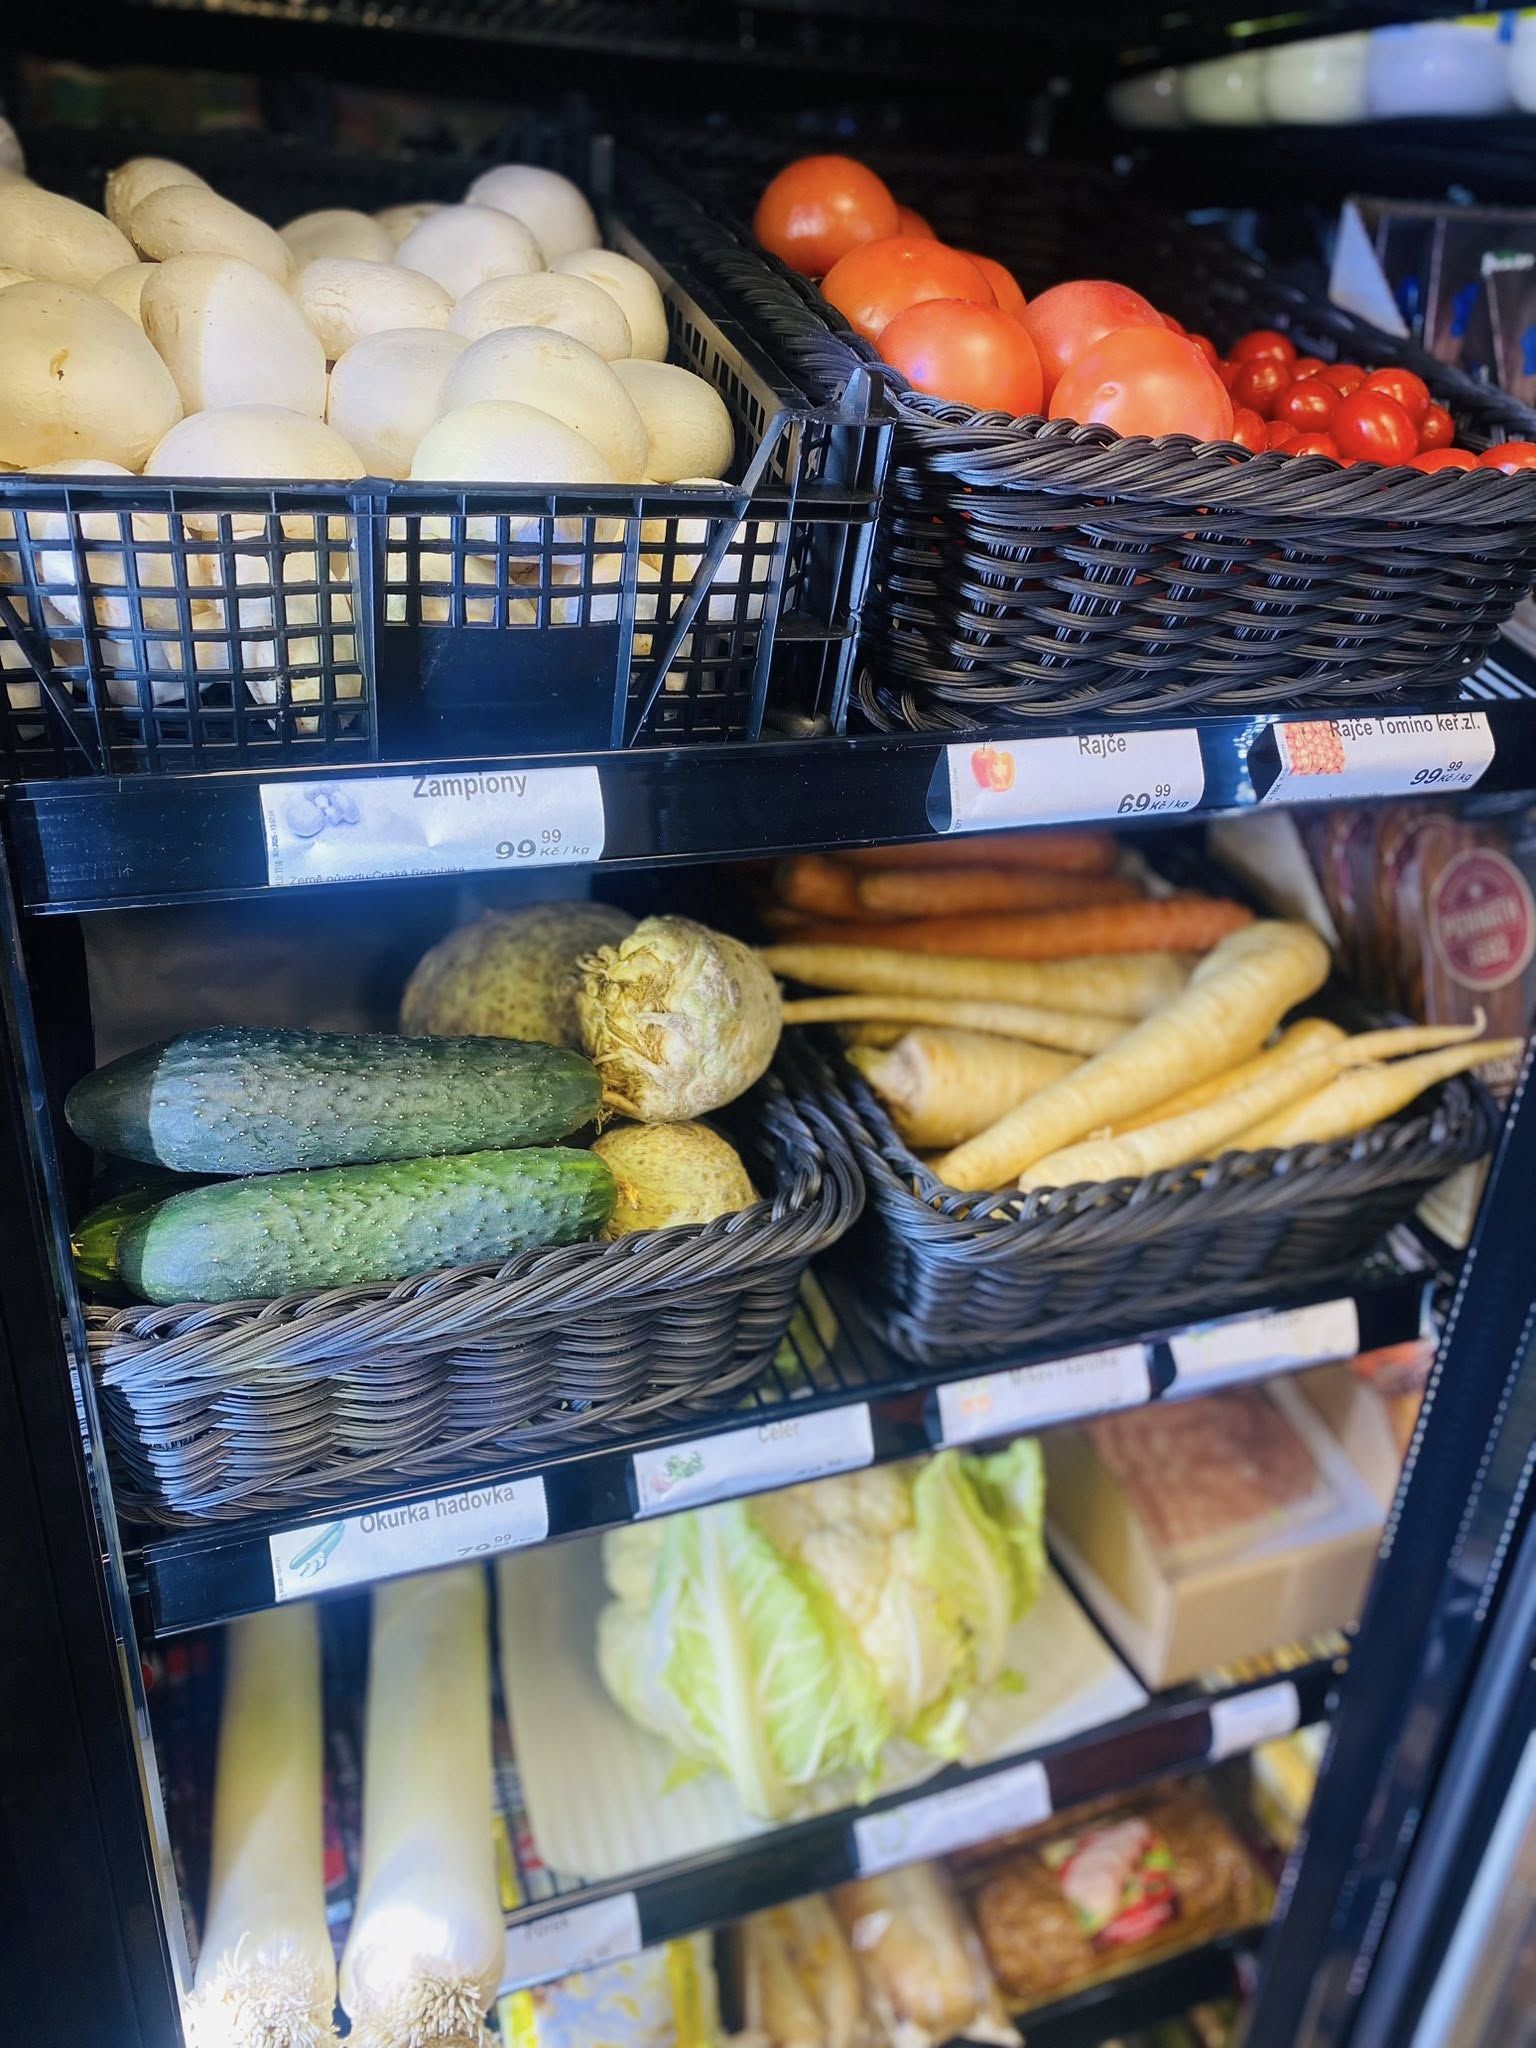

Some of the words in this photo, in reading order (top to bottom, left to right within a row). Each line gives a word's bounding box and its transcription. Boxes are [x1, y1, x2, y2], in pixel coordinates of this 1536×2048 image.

[1329, 717, 1373, 741] Rajče
[1375, 715, 1433, 735] Tomino
[1078, 732, 1126, 758] Rajče
[1410, 767, 1443, 785] 99
[1447, 761, 1463, 772] 99
[1117, 792, 1151, 814] 69
[1155, 784, 1171, 797] 99
[495, 838, 537, 860] 99
[541, 828, 562, 843] 99
[359, 1505, 430, 1534] Okurka
[435, 1485, 515, 1519] hadovka
